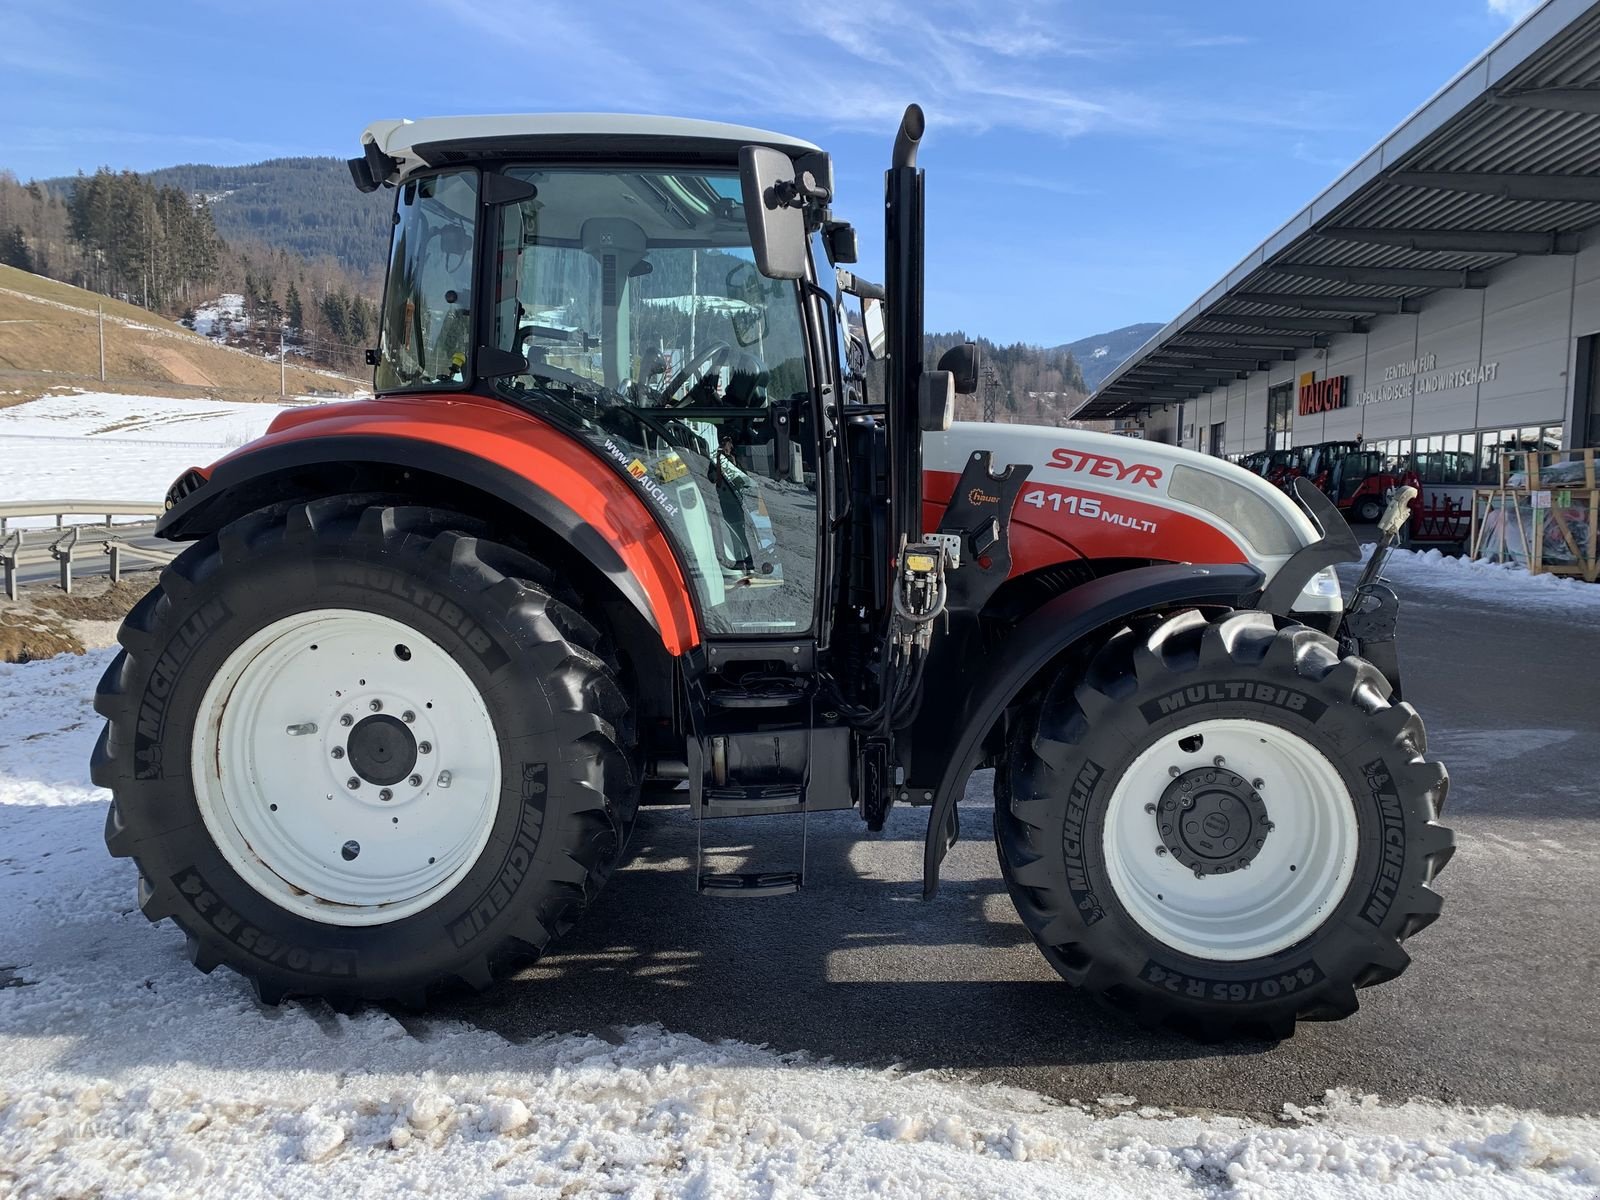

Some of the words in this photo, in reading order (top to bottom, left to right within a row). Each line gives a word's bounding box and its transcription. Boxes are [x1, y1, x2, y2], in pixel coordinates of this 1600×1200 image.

[1384, 354, 1418, 381] ZENTRUM
[1419, 352, 1437, 372] FÜR
[1415, 362, 1498, 394] LANDWIRTSCHAFT
[1299, 375, 1345, 416] MAUCH
[604, 438, 678, 517] www.MAUCH.at
[1045, 447, 1163, 489] STEYR
[973, 491, 1001, 503] hauer
[1023, 489, 1102, 519] 4115
[1101, 510, 1157, 534] MULTI
[338, 562, 492, 654] MULTIBIB
[137, 600, 225, 741] MICHELIN
[1157, 681, 1309, 714] MULTIBIB
[1064, 761, 1099, 891] MICHELIN
[453, 802, 545, 948] MICHELIN
[1366, 793, 1404, 925] MICHELIN
[212, 907, 241, 935] R
[1148, 966, 1183, 992] 24
[1186, 978, 1207, 999] R
[1212, 967, 1315, 1002] 440/65
